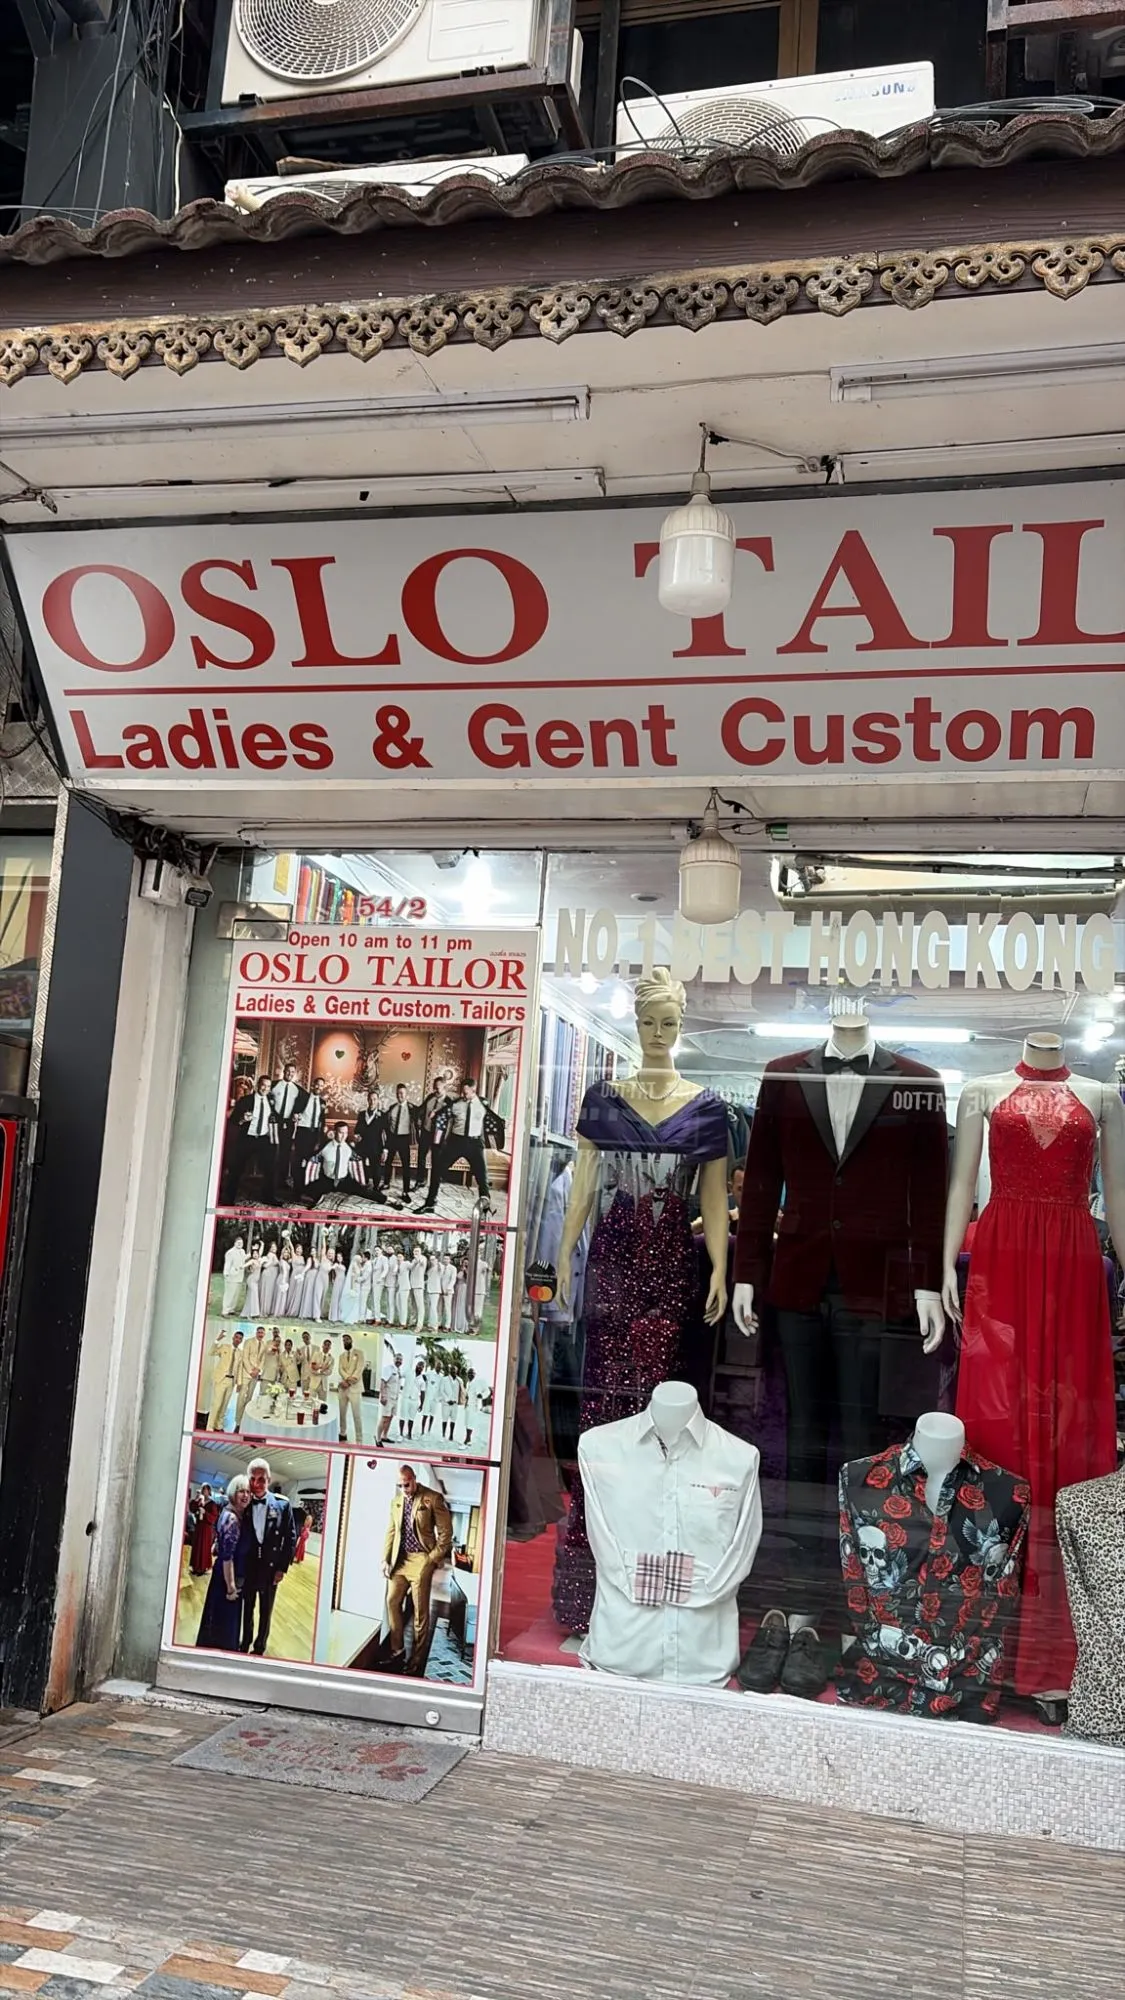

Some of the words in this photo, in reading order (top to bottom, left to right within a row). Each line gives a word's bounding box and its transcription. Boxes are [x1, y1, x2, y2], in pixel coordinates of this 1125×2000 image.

[42, 548, 549, 673] OSLO
[69, 706, 334, 770] Ladies
[372, 704, 432, 769] &
[467, 703, 678, 769] Gent
[721, 697, 1096, 766] Custom
[359, 896, 427, 918] 54/2
[288, 931, 331, 949] Open
[338, 933, 358, 948] 10
[363, 936, 389, 949] am
[395, 935, 412, 949] to
[420, 936, 439, 950] 11
[446, 938, 473, 954] pm
[670, 910, 794, 985] BEST
[807, 910, 950, 989] HONG
[964, 911, 1115, 993] KONG
[239, 952, 351, 985] OSLO
[366, 955, 527, 990] TAILOR
[234, 992, 295, 1014] Ladies
[303, 994, 316, 1015] &
[324, 995, 371, 1017] Gent
[459, 999, 526, 1022] Tailors
